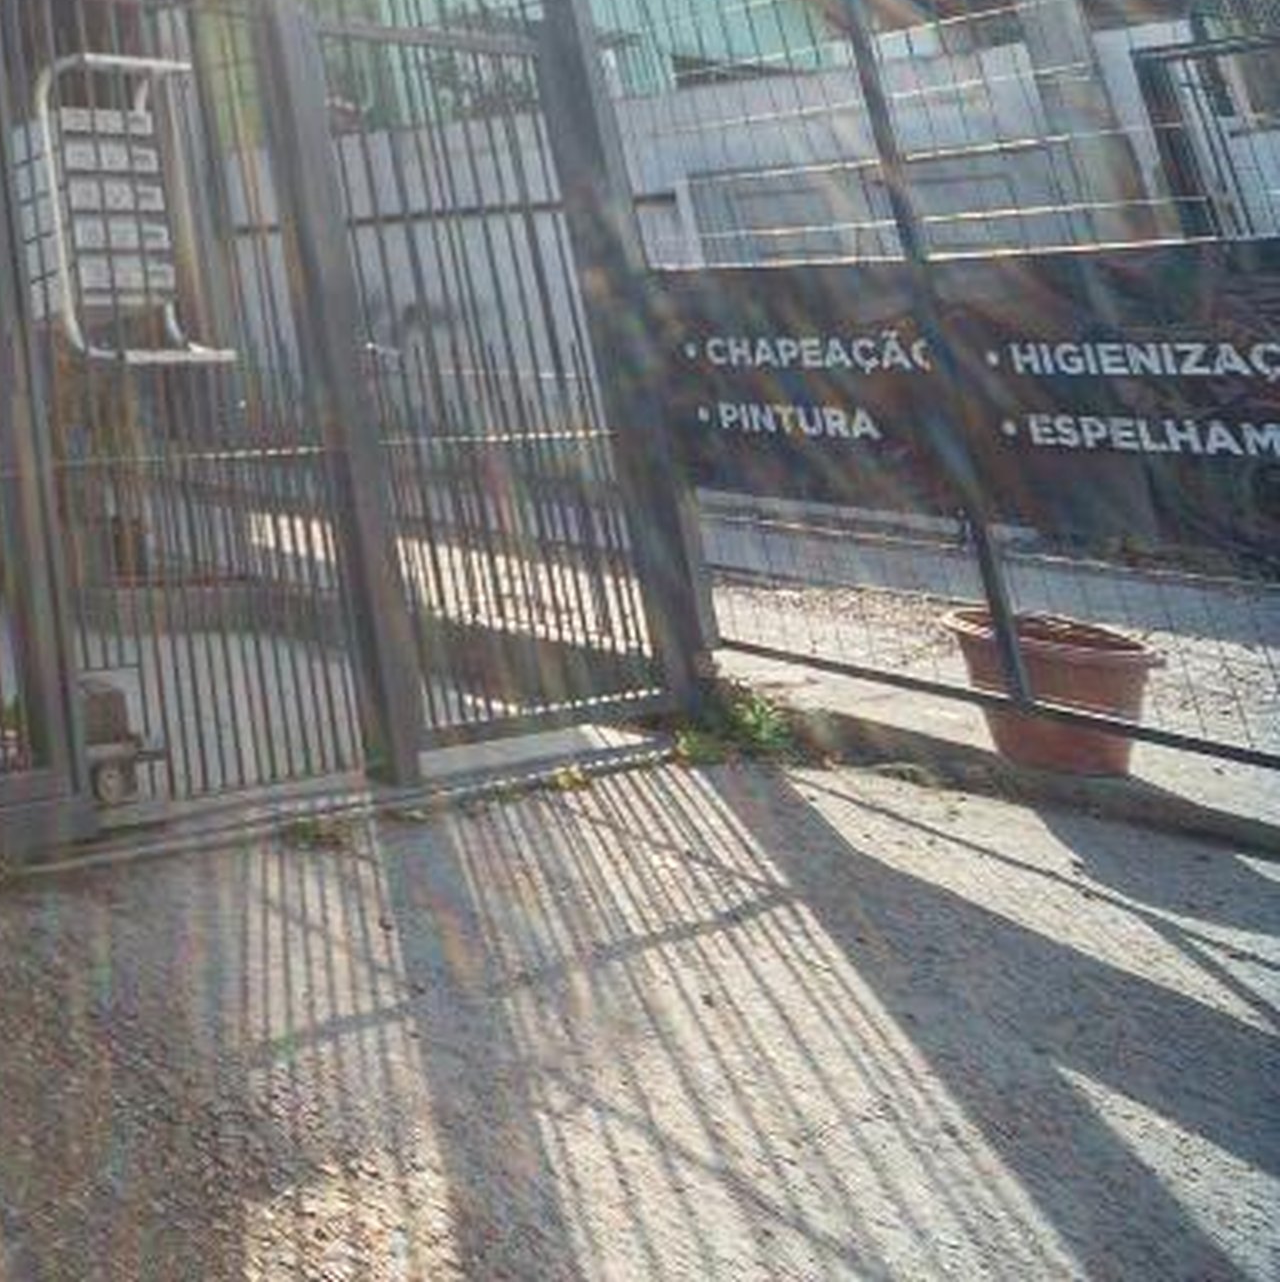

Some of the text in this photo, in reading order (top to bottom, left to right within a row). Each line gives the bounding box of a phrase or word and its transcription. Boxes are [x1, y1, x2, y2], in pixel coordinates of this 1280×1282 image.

[1011, 340, 1280, 383] HIGIENIZAÇ
[720, 401, 882, 441] PINTURA
[1030, 413, 1280, 456] ESPELHAM
